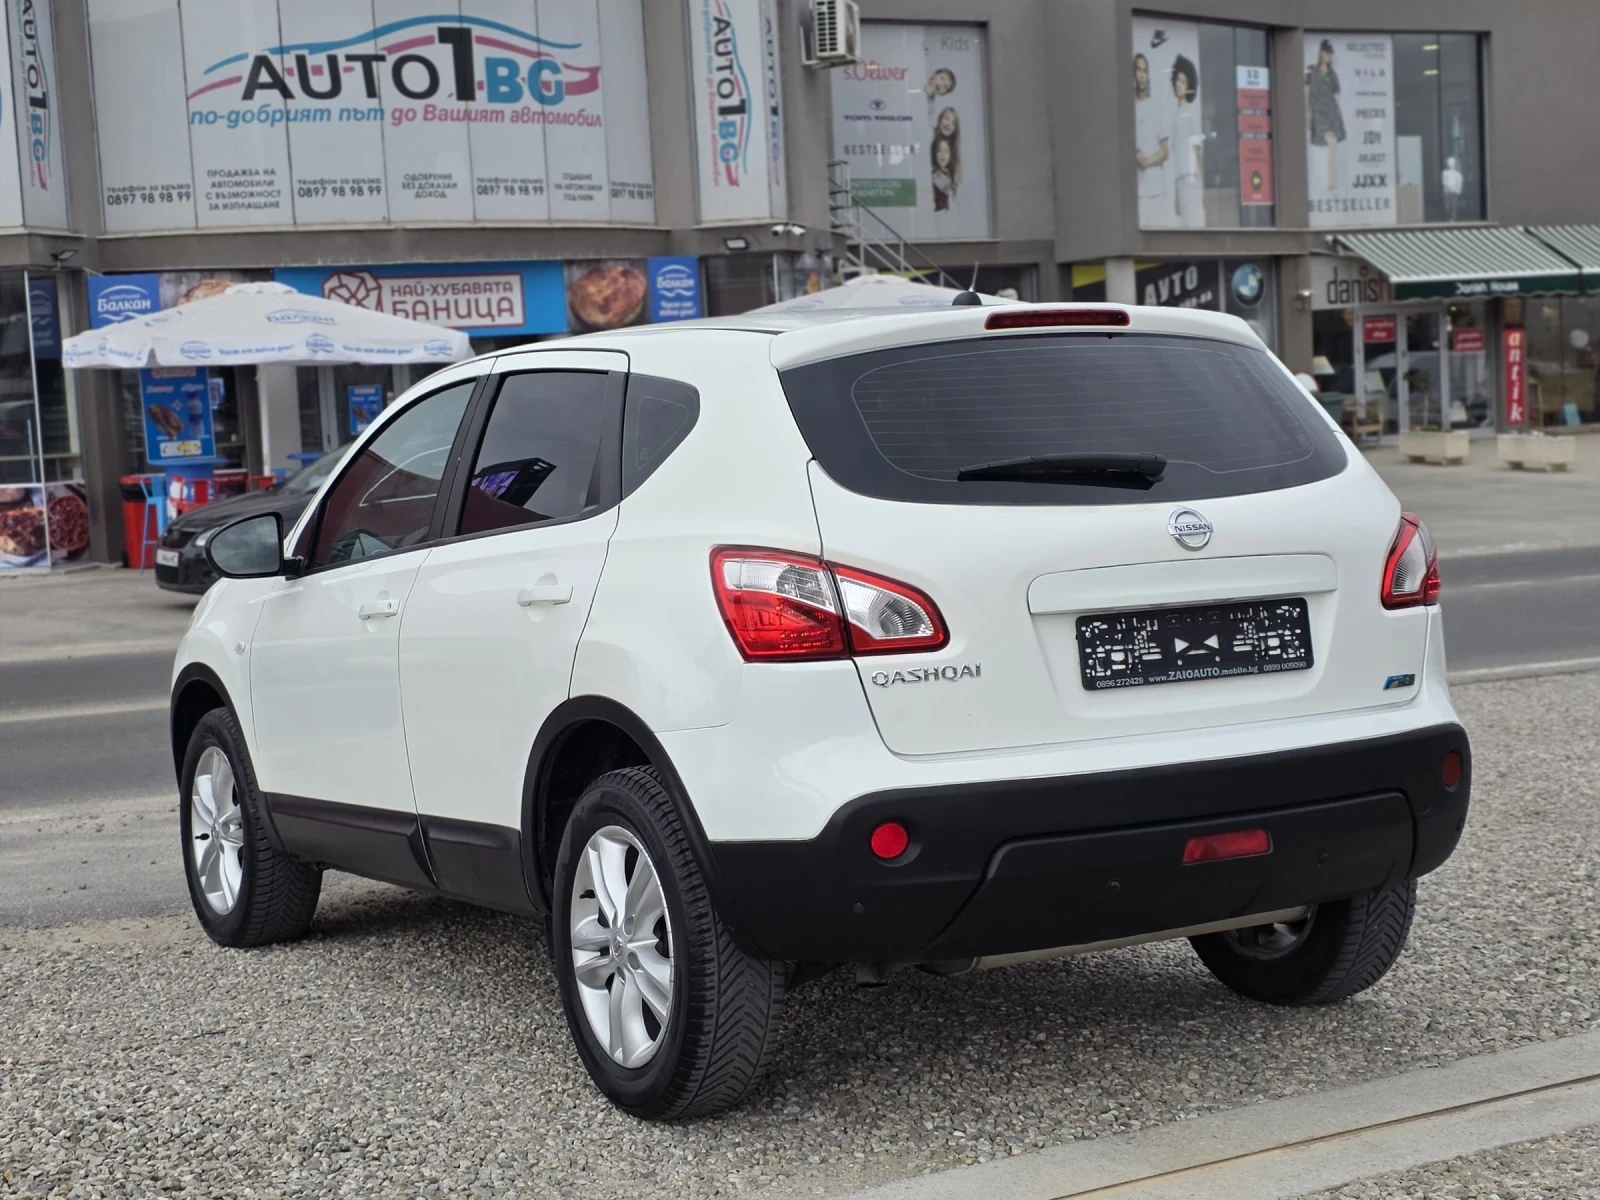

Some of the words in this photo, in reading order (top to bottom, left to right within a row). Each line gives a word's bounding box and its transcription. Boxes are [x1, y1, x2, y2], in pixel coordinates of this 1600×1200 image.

[1355, 68, 1386, 77] VILA
[190, 104, 332, 128] по-добрият
[338, 107, 385, 122] път
[391, 107, 417, 126] до
[423, 104, 505, 123] Вашият
[510, 106, 602, 127] автомобил
[207, 168, 260, 178] ПРОДАЖБА
[263, 168, 276, 176] НА
[210, 179, 275, 189] АВТОМОБИЛИ
[402, 182, 415, 190] БЕЗ
[1353, 174, 1387, 188] JJXX
[106, 184, 147, 194] телефон
[205, 192, 212, 200] С
[215, 190, 281, 199] ВЪЗМОЖНОСТ
[298, 187, 327, 198] 0897
[332, 187, 346, 197] 98
[350, 186, 364, 197] 98
[368, 185, 382, 196] 99
[414, 190, 447, 198] ДОХОД
[476, 185, 500, 196] 0897
[504, 185, 516, 196] 98
[518, 185, 530, 196] 98
[533, 185, 544, 196] 99
[107, 193, 136, 206] 0897
[140, 193, 155, 204] 98
[158, 192, 173, 203] 98
[177, 191, 191, 202] 99
[1308, 197, 1390, 213] BESTSELLER
[208, 203, 220, 211] ЗА
[222, 202, 280, 210] ИЗПЛАЩАНЕ
[391, 281, 513, 297] НАЙ-ХУБАВАТА
[97, 298, 151, 312] Балкан
[392, 296, 514, 322] БАНИЦА
[1508, 332, 1523, 422] antik
[1174, 523, 1211, 533] NISSAN
[871, 662, 982, 688] QASHQAI
[1096, 680, 1116, 688] 0896
[1116, 677, 1144, 687] 272428
[1148, 666, 1259, 682] www.ZAIOAUTO.mobile.bg
